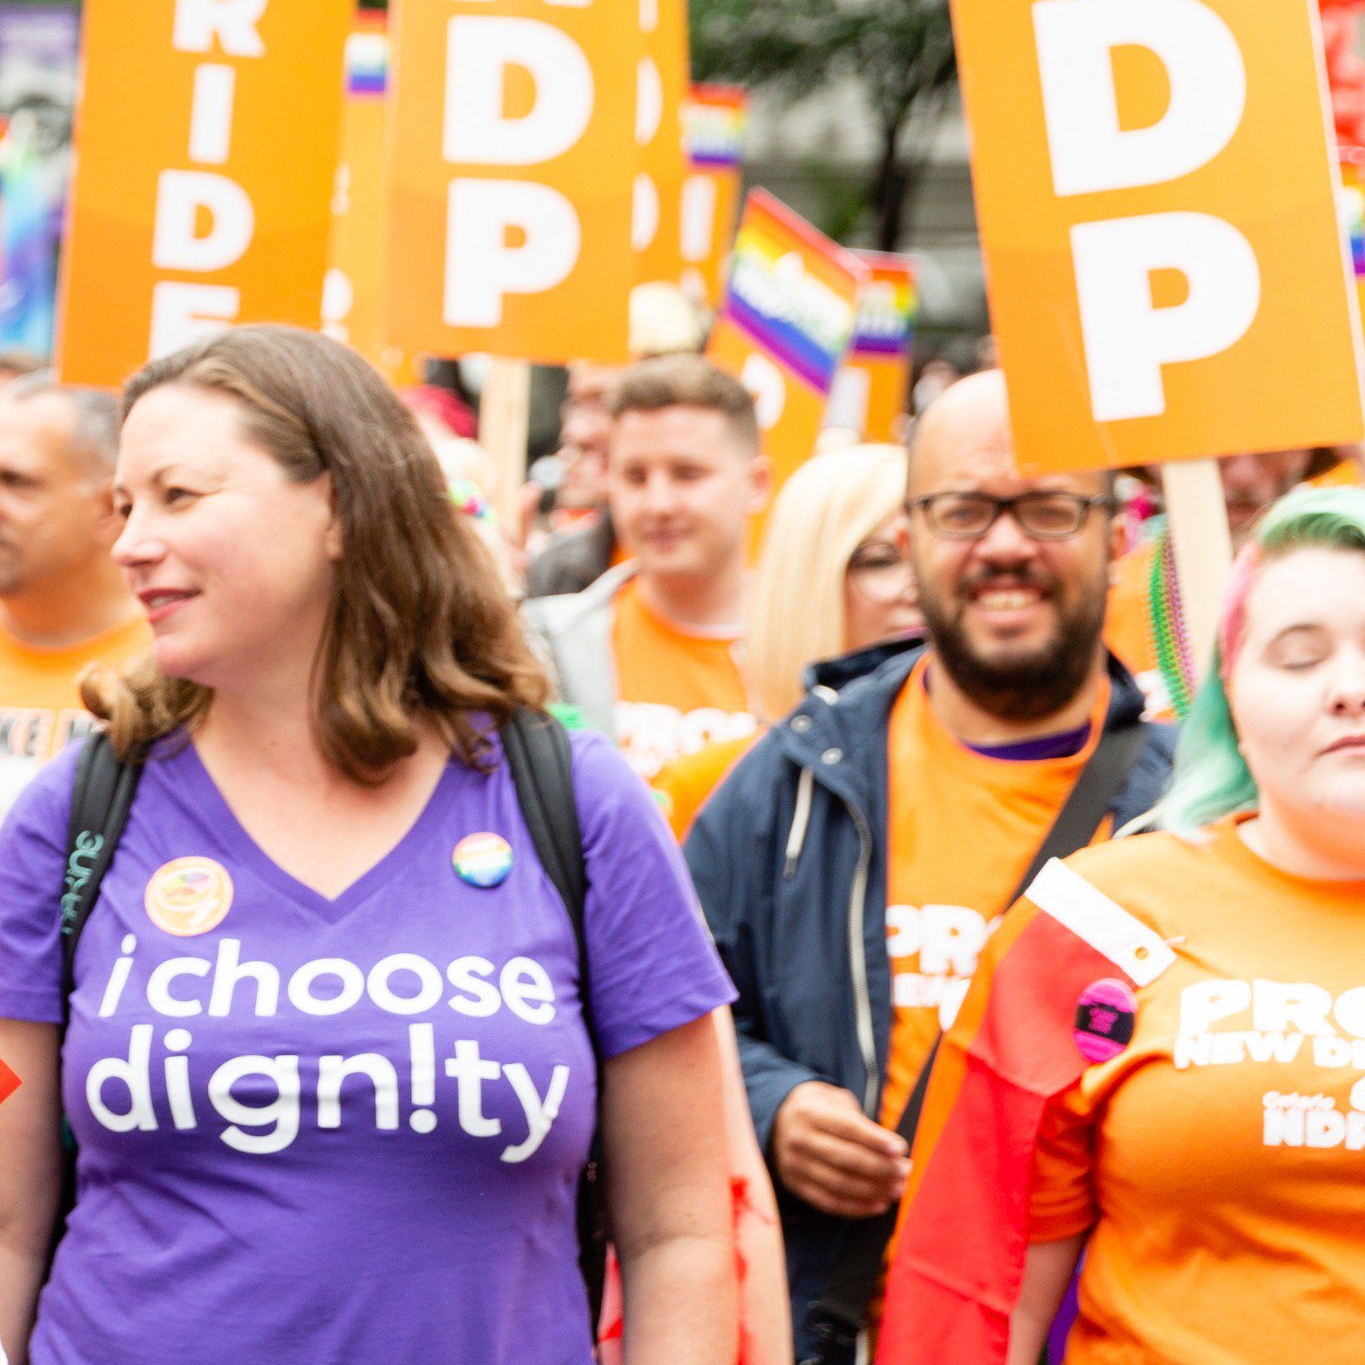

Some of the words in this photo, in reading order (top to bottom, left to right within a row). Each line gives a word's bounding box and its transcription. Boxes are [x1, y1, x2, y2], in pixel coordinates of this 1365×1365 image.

[99, 934, 137, 1017] i
[147, 938, 557, 1025] choose
[85, 1022, 570, 1163] dign!ty
[1174, 1030, 1305, 1069] NEW
